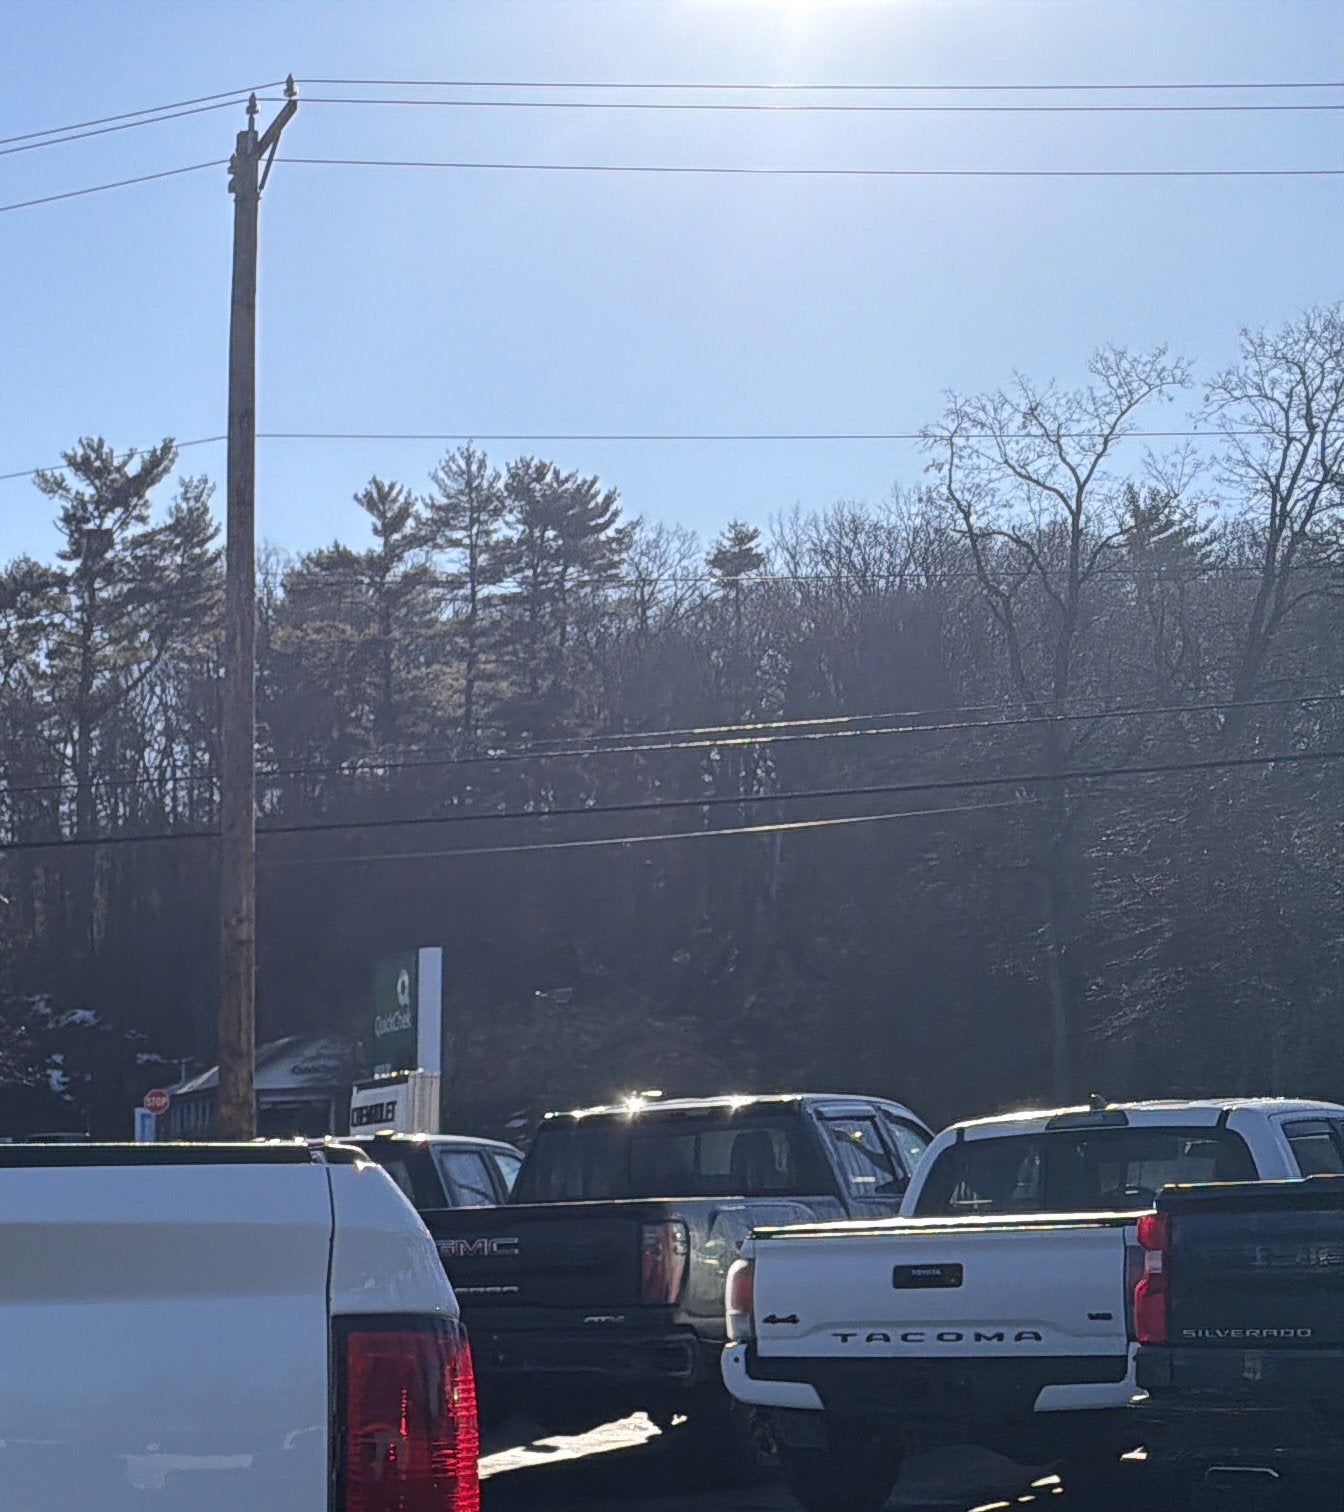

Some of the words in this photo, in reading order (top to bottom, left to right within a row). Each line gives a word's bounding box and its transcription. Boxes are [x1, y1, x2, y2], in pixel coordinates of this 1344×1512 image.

[146, 1096, 168, 1107] STOP
[831, 1331, 1043, 1344] TACOMA
[1182, 1328, 1312, 1338] SILVERADO
